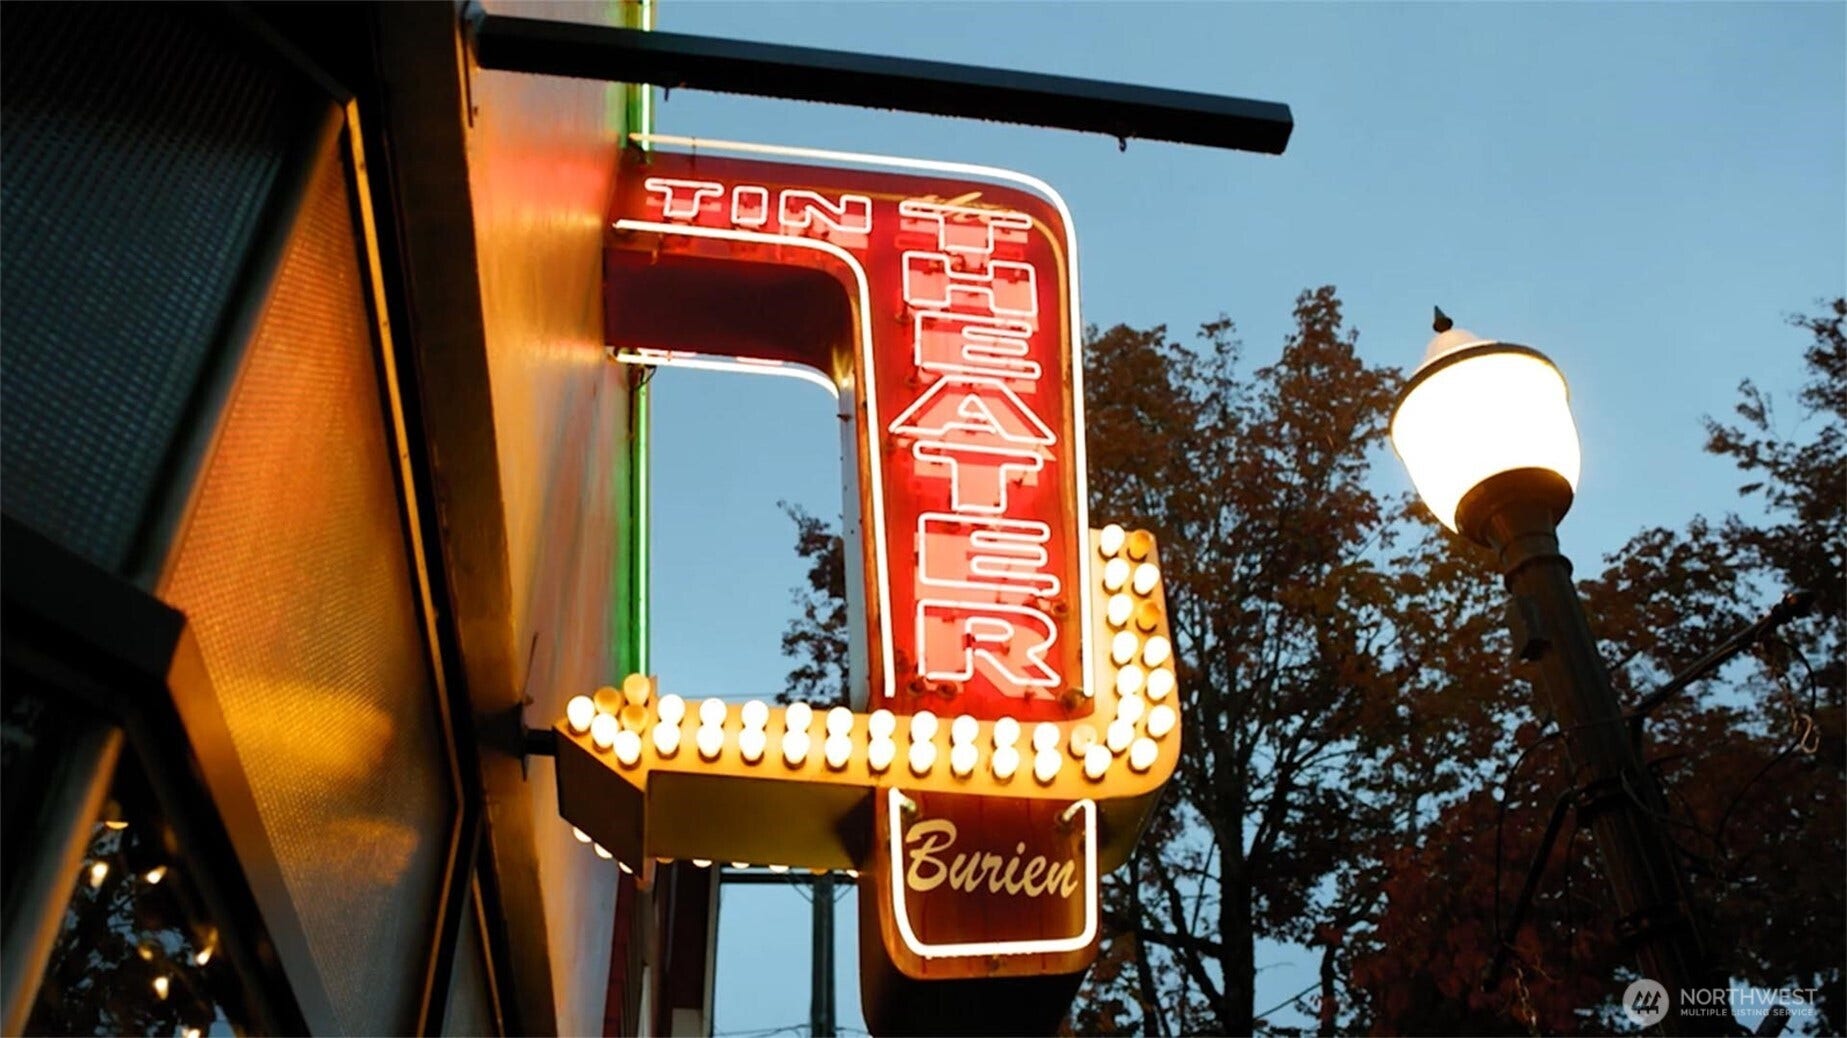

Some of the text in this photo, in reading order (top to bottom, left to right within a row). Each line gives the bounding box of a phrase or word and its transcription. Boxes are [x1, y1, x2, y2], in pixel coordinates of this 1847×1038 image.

[645, 177, 872, 235] TIN
[888, 199, 1058, 687] THEATER
[905, 819, 1078, 898] Burien
